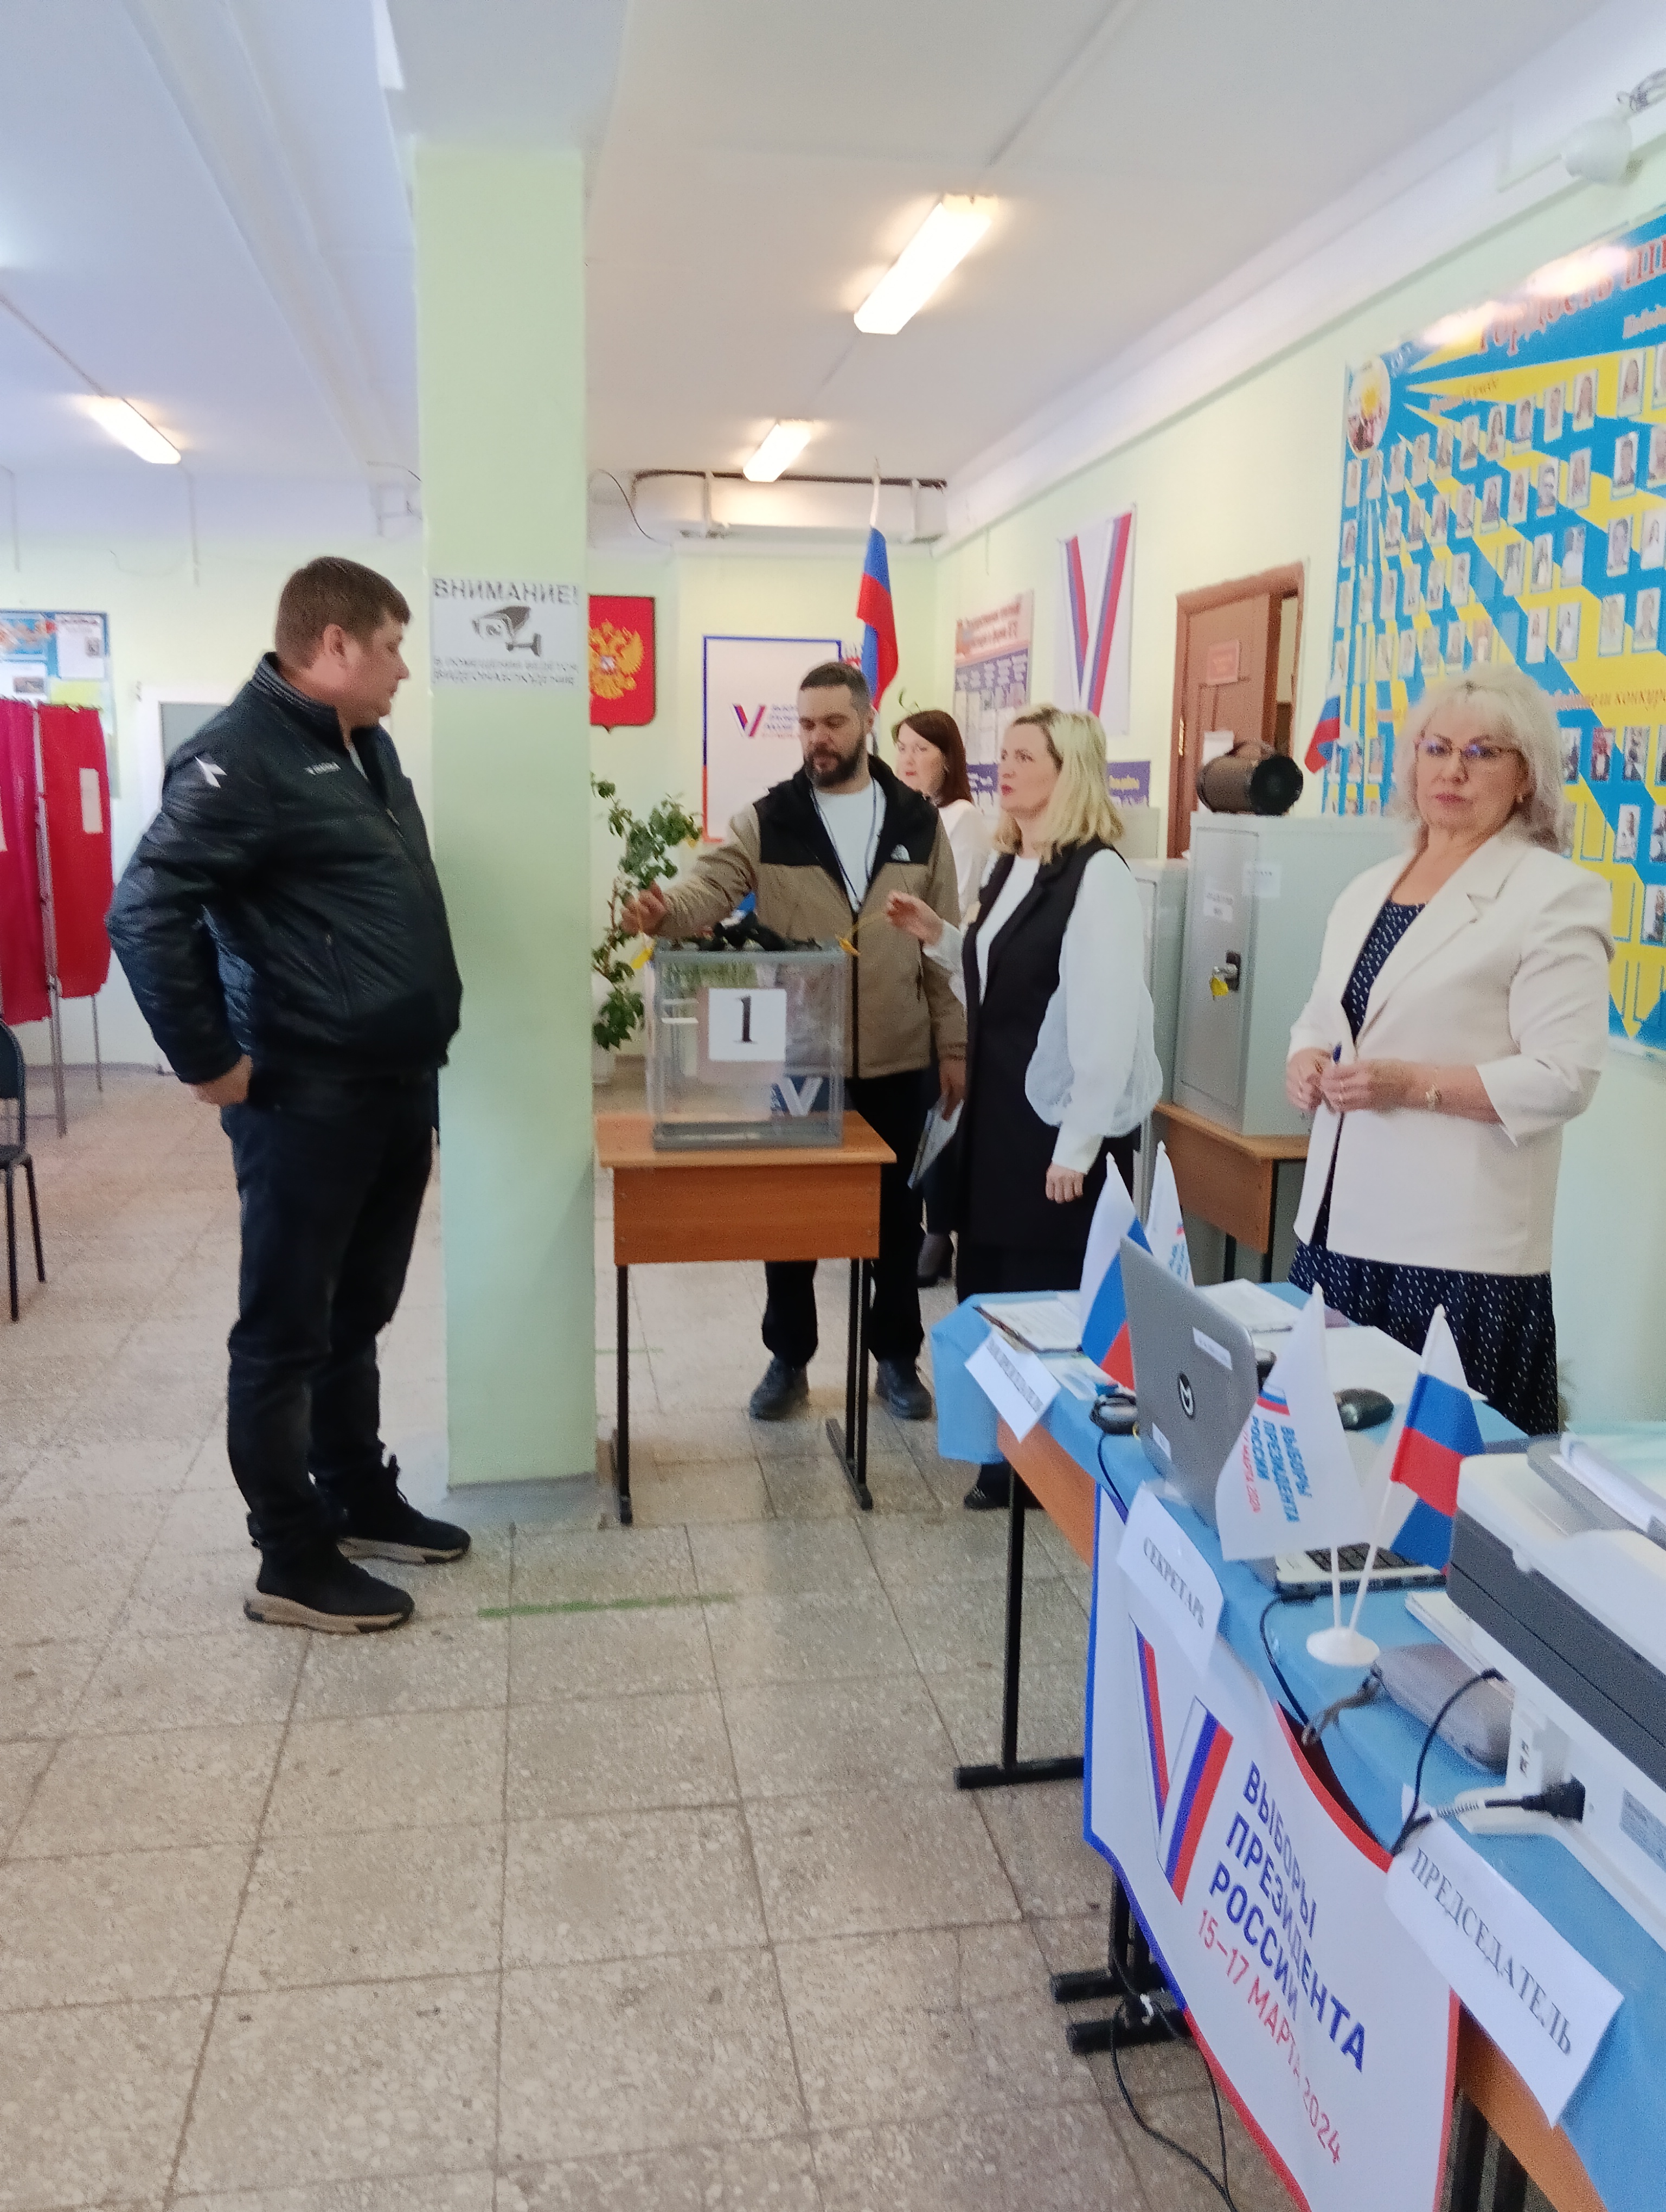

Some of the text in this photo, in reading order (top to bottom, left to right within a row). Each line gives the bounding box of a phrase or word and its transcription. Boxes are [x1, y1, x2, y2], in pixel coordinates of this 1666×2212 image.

[434, 578, 579, 605] ВНИМАНИЕ!
[735, 994, 757, 1044] 1
[1143, 1536, 1204, 1629] СЕКРЕТАРЬ
[1242, 1760, 1317, 1939] ВЫБОРЫ
[1209, 1860, 1297, 2021] РОССИИ
[1226, 1811, 1364, 2072] ПРЕЗИДЕНТА
[1411, 1847, 1571, 2055] ПРЕДСЕДАТЕЛЬ
[1303, 2076, 1340, 2163] 2024
